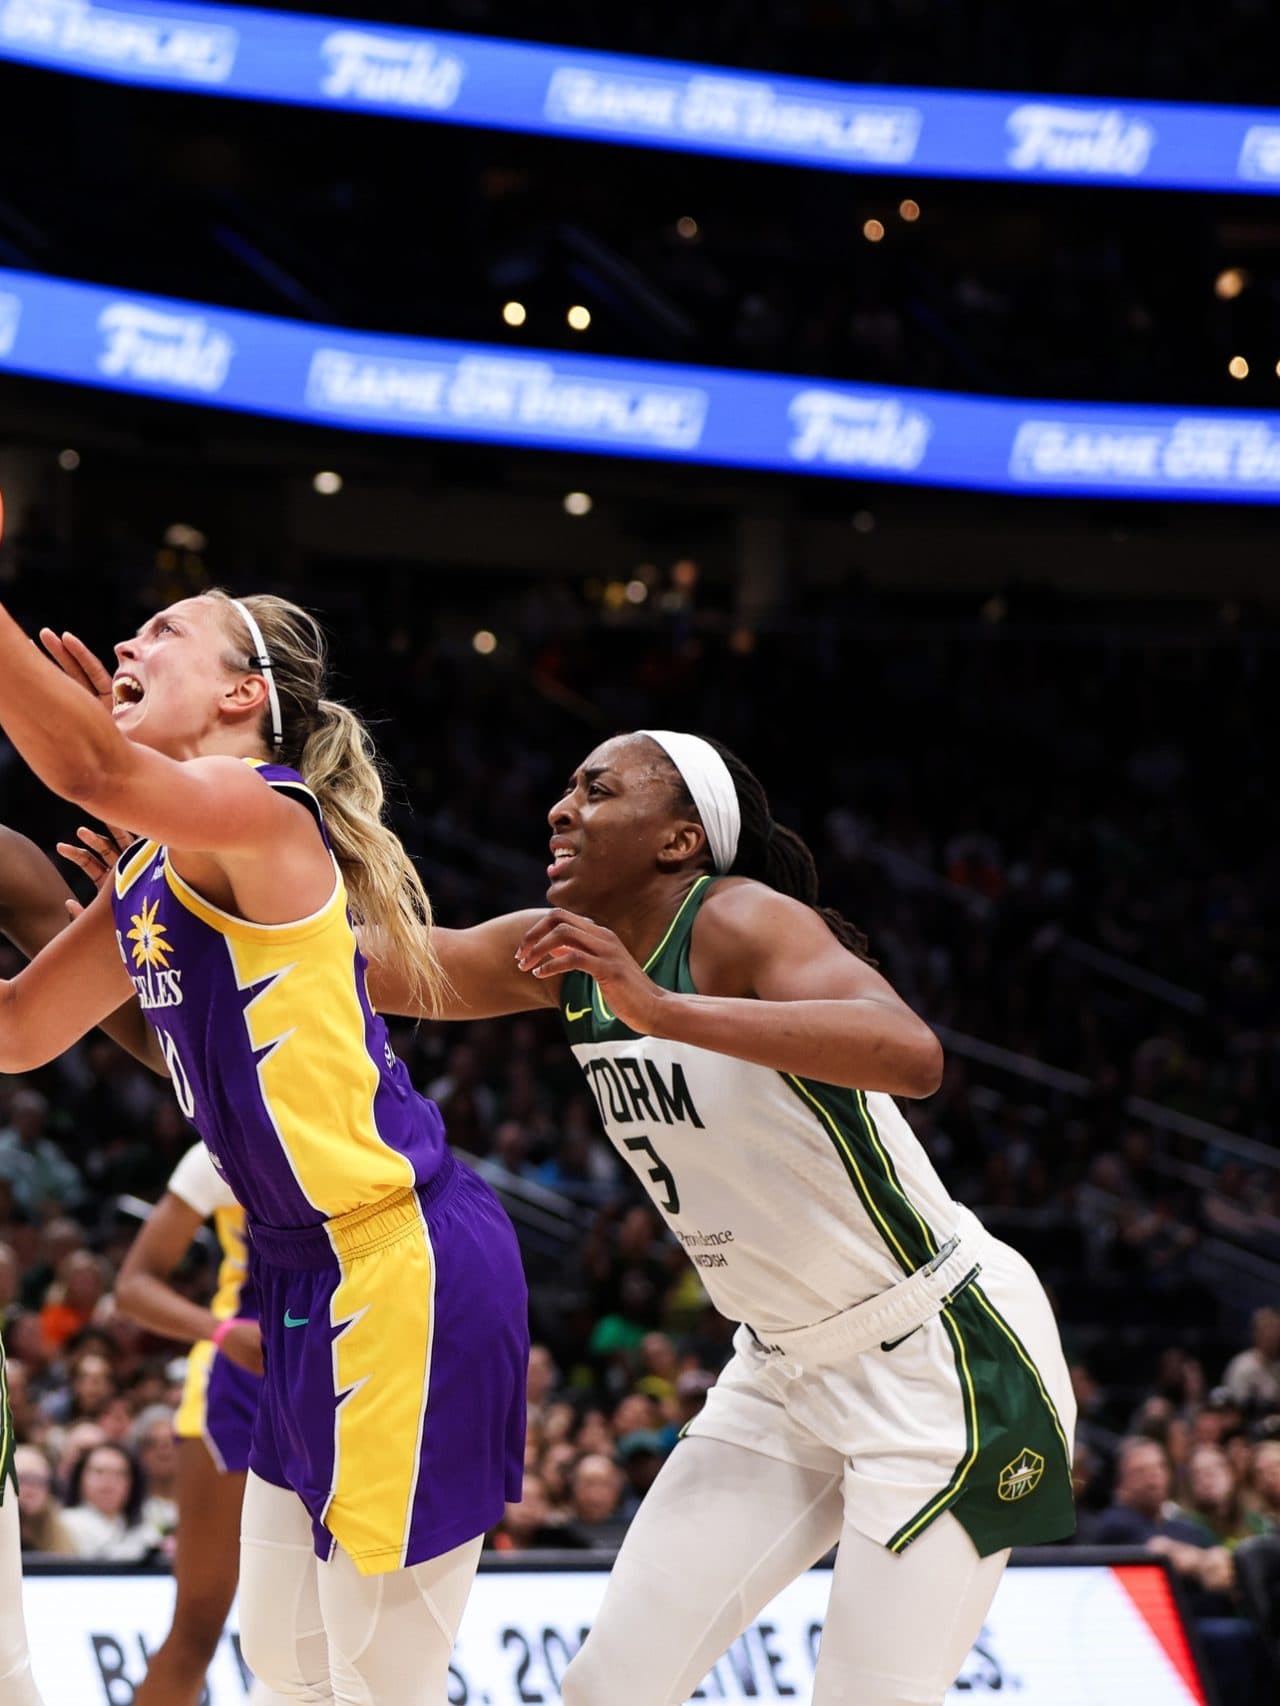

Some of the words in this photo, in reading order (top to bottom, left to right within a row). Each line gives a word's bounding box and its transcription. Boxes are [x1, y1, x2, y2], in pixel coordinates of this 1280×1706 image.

[321, 30, 464, 111] Funko
[1004, 104, 1155, 177] Funko
[98, 302, 235, 393] Funko
[787, 389, 933, 474] Funko
[583, 1057, 706, 1130] TORM
[623, 1135, 680, 1215] 3
